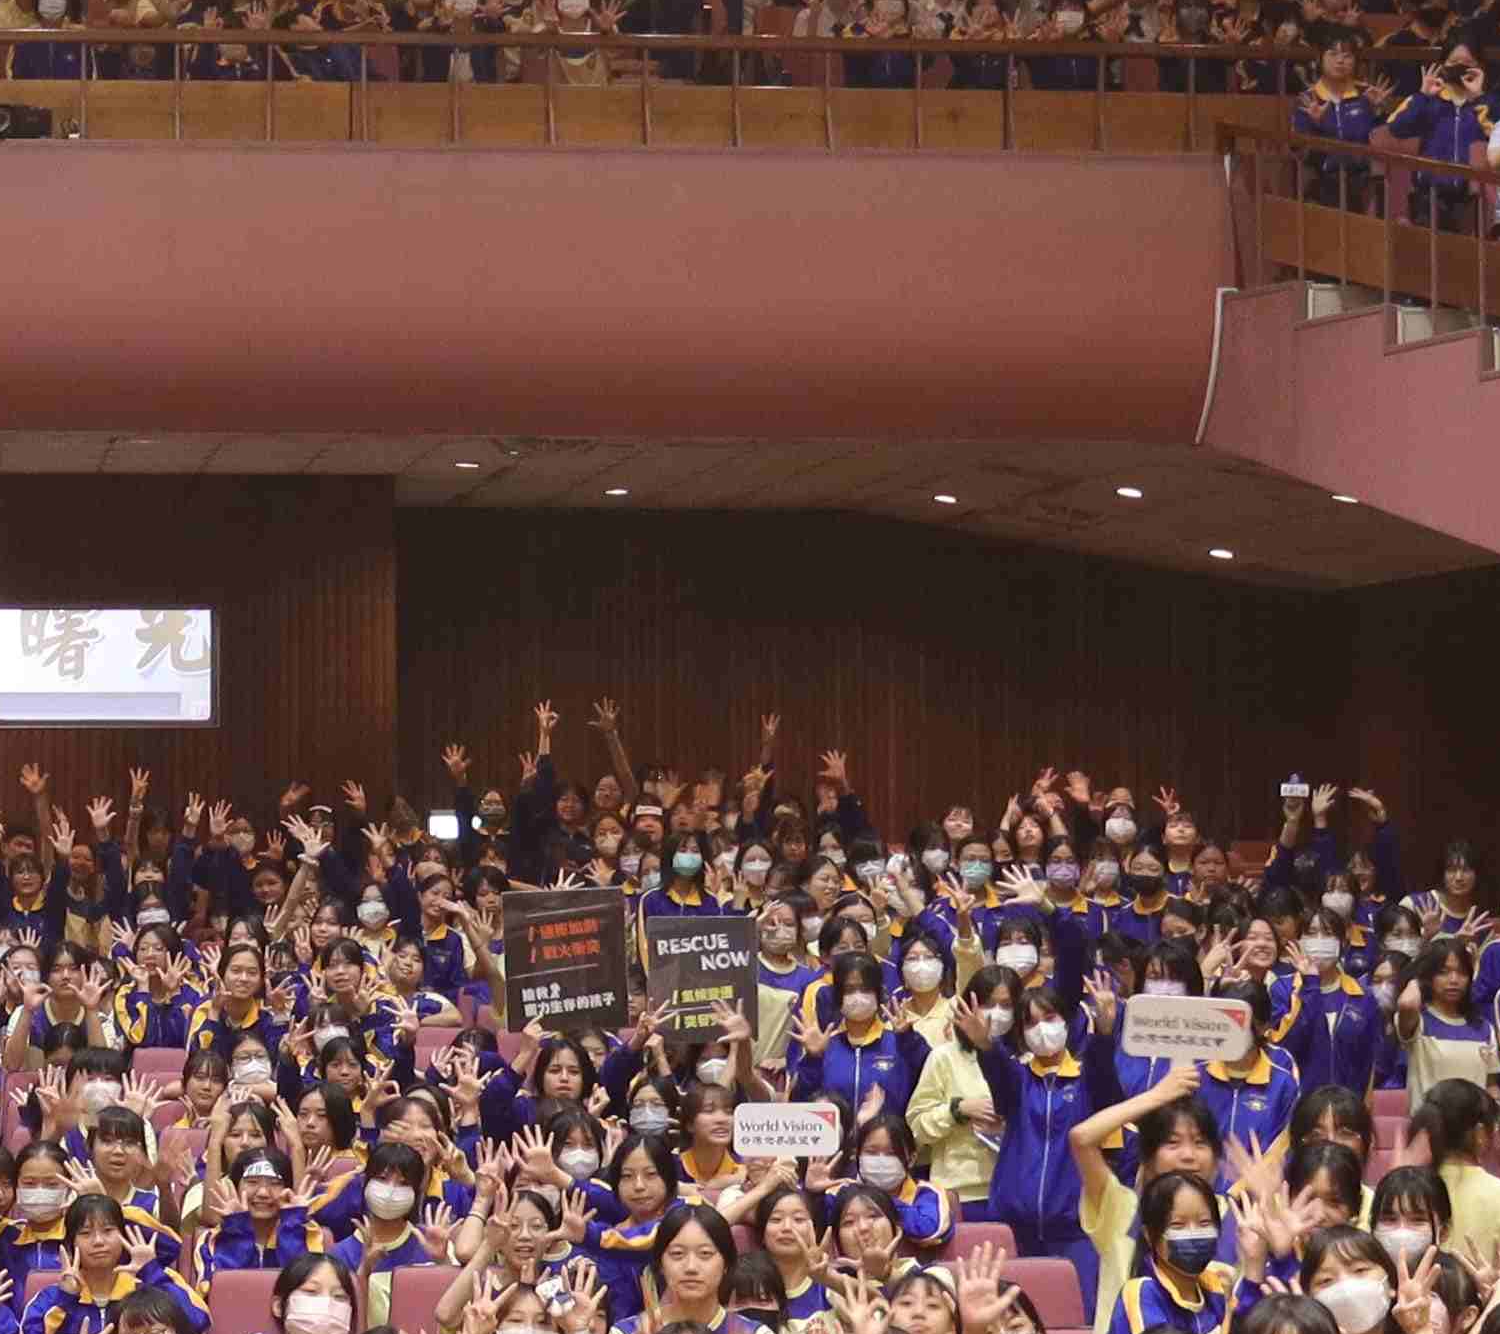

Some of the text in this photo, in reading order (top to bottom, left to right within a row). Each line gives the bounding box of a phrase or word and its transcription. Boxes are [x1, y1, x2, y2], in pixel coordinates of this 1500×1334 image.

[656, 933, 729, 956] RESCUE
[700, 951, 751, 971] NOW
[739, 1120, 823, 1132] World Vision
